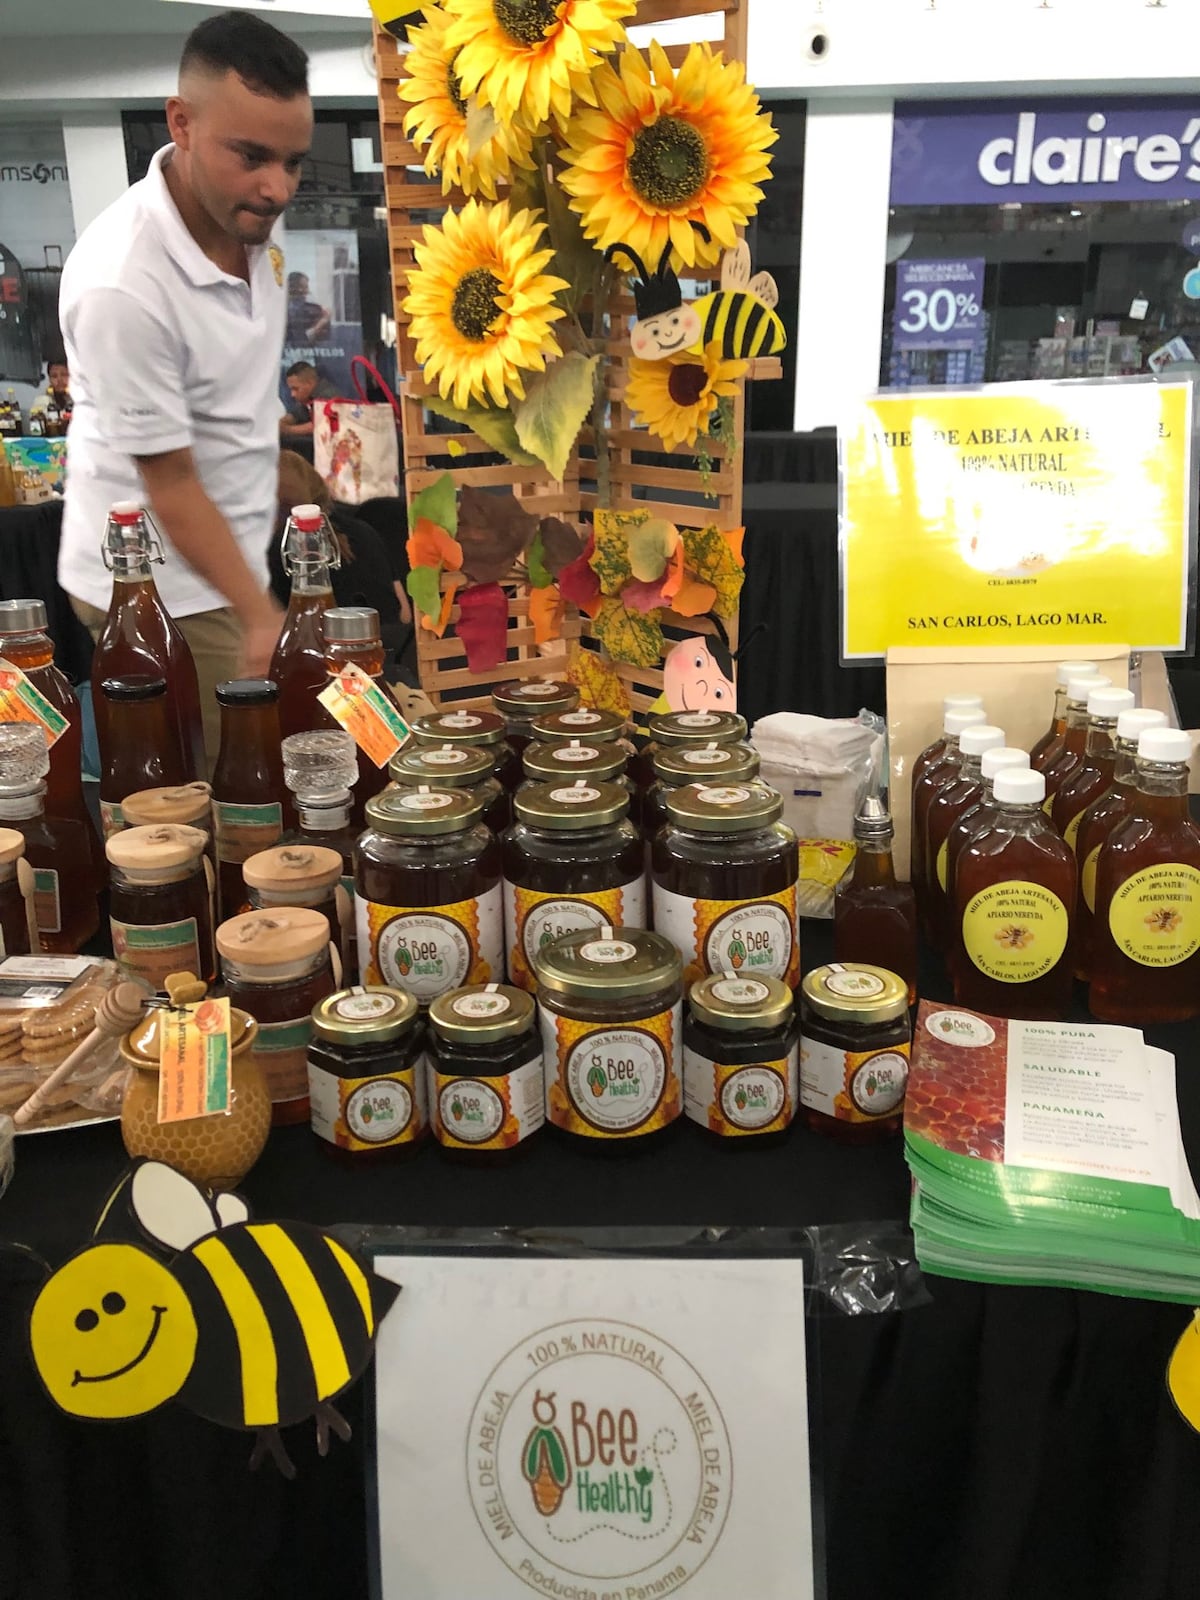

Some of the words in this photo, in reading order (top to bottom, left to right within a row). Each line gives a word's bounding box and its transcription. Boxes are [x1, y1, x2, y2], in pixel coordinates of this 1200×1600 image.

[900, 288, 980, 333] 30%
[966, 427, 1033, 446] ABEJA
[998, 452, 1067, 473] NATURAL
[907, 616, 939, 630] SAN
[943, 614, 1012, 629] CARLOS,
[1016, 613, 1062, 627] LAGO
[1066, 612, 1107, 625] MAR.
[1120, 882, 1135, 899] MIEL
[1136, 876, 1146, 885] DE
[1149, 871, 1173, 879] ABEJA
[970, 898, 984, 914] MIEL
[983, 892, 994, 901] DE
[995, 888, 1020, 897] ABEJA
[1022, 888, 1060, 912] ARTESANAL
[411, 940, 437, 961] Bee
[746, 931, 770, 952] Bee
[1025, 1027, 1057, 1036] 100%
[1060, 1030, 1097, 1038] PURA
[607, 1058, 634, 1081] Bee
[1023, 1063, 1102, 1077] SALUDABLE
[373, 1097, 390, 1112] Bee
[747, 1084, 764, 1099] Bee
[582, 1332, 666, 1375] NATURAL
[478, 1389, 510, 1454] ABEJA
[685, 1391, 714, 1443] MIEL
[571, 1400, 638, 1467] Bee
[478, 1457, 496, 1487] DE
[704, 1447, 721, 1476] DE
[577, 1467, 654, 1523] Healthy
[485, 1490, 514, 1541] MIEL
[686, 1481, 720, 1545] ABEJA
[519, 1558, 597, 1600] Producida
[625, 1565, 687, 1600] Panama
